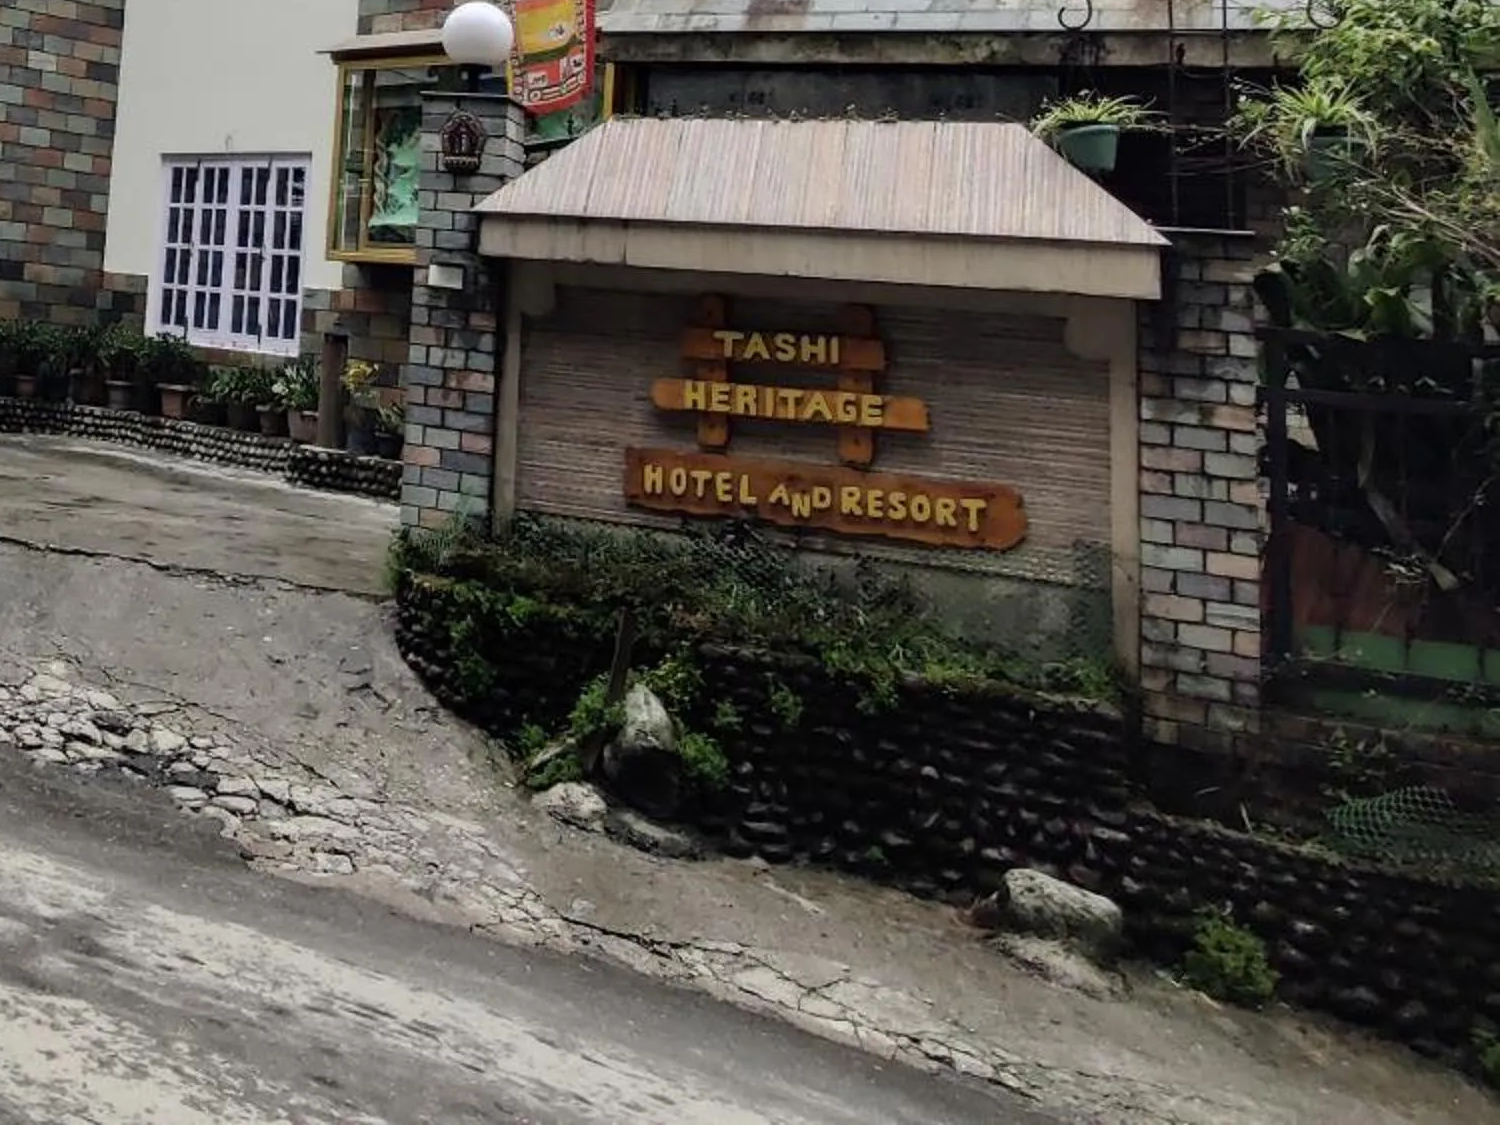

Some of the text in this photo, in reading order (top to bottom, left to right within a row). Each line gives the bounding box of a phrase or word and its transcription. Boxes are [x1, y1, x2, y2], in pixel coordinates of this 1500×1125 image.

[715, 330, 839, 364] TASHI
[683, 381, 885, 425] HERITAGE
[644, 465, 988, 531] HOTEL AND RESORT
